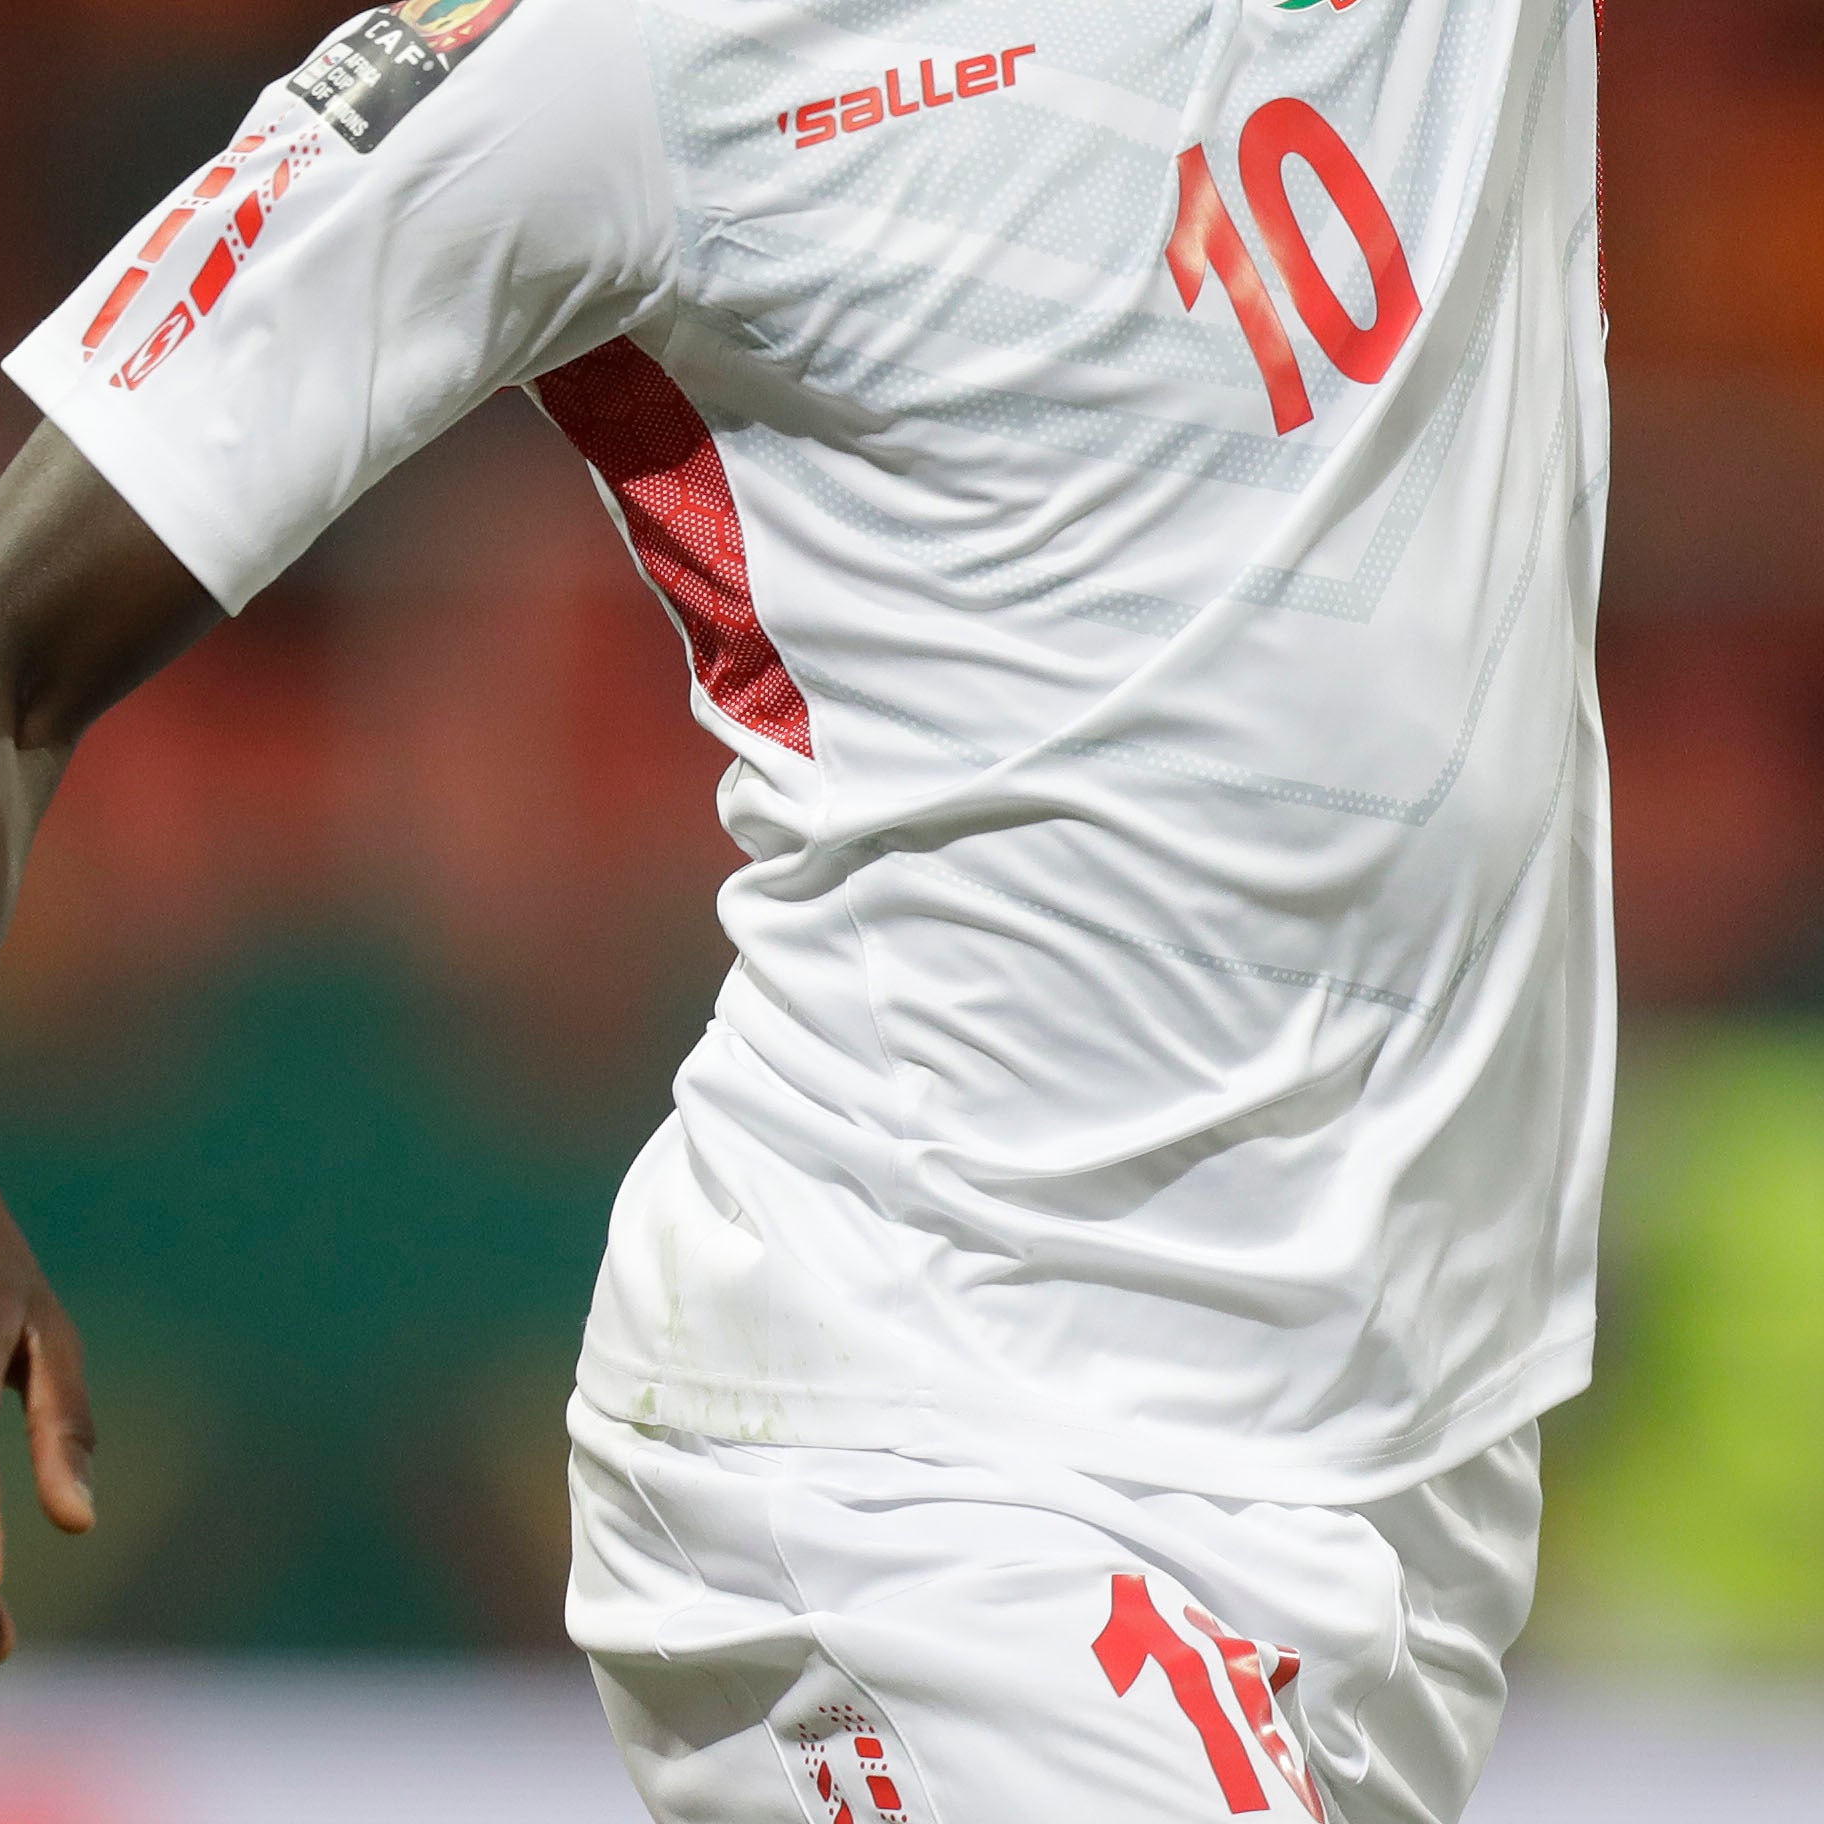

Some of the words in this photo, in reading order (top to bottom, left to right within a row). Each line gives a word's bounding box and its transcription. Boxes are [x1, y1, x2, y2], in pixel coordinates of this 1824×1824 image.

[364, 20, 426, 65] CAF
[311, 81, 334, 101] OF
[327, 66, 355, 90] CUP
[1165, 97, 1423, 437] 10
